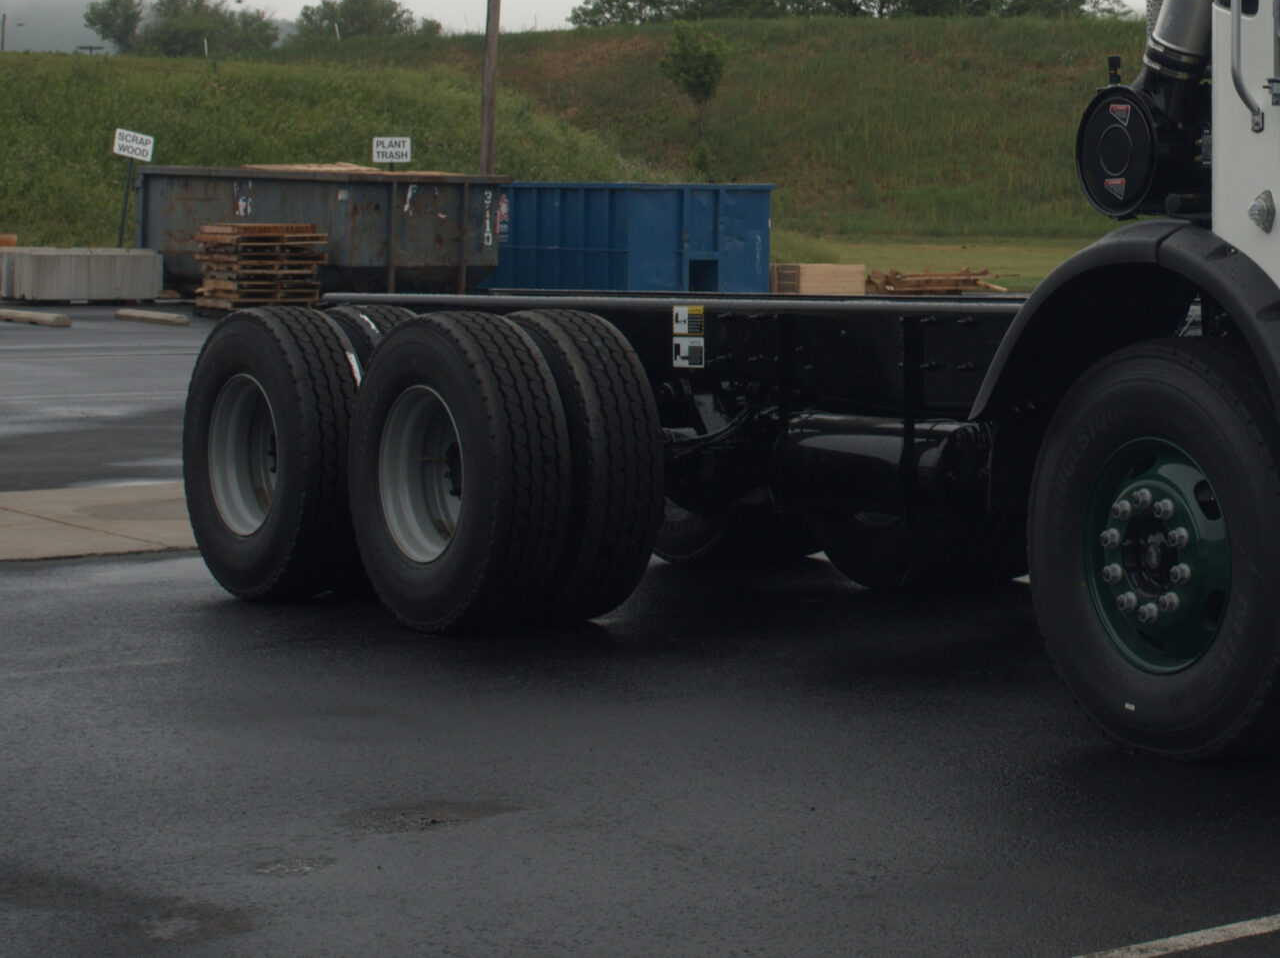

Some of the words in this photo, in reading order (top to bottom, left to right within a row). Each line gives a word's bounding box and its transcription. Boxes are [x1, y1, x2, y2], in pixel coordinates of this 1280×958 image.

[118, 132, 152, 146] SCRAP
[376, 140, 407, 149] PLANT
[118, 143, 149, 158] WOOD
[376, 151, 408, 159] TRASH
